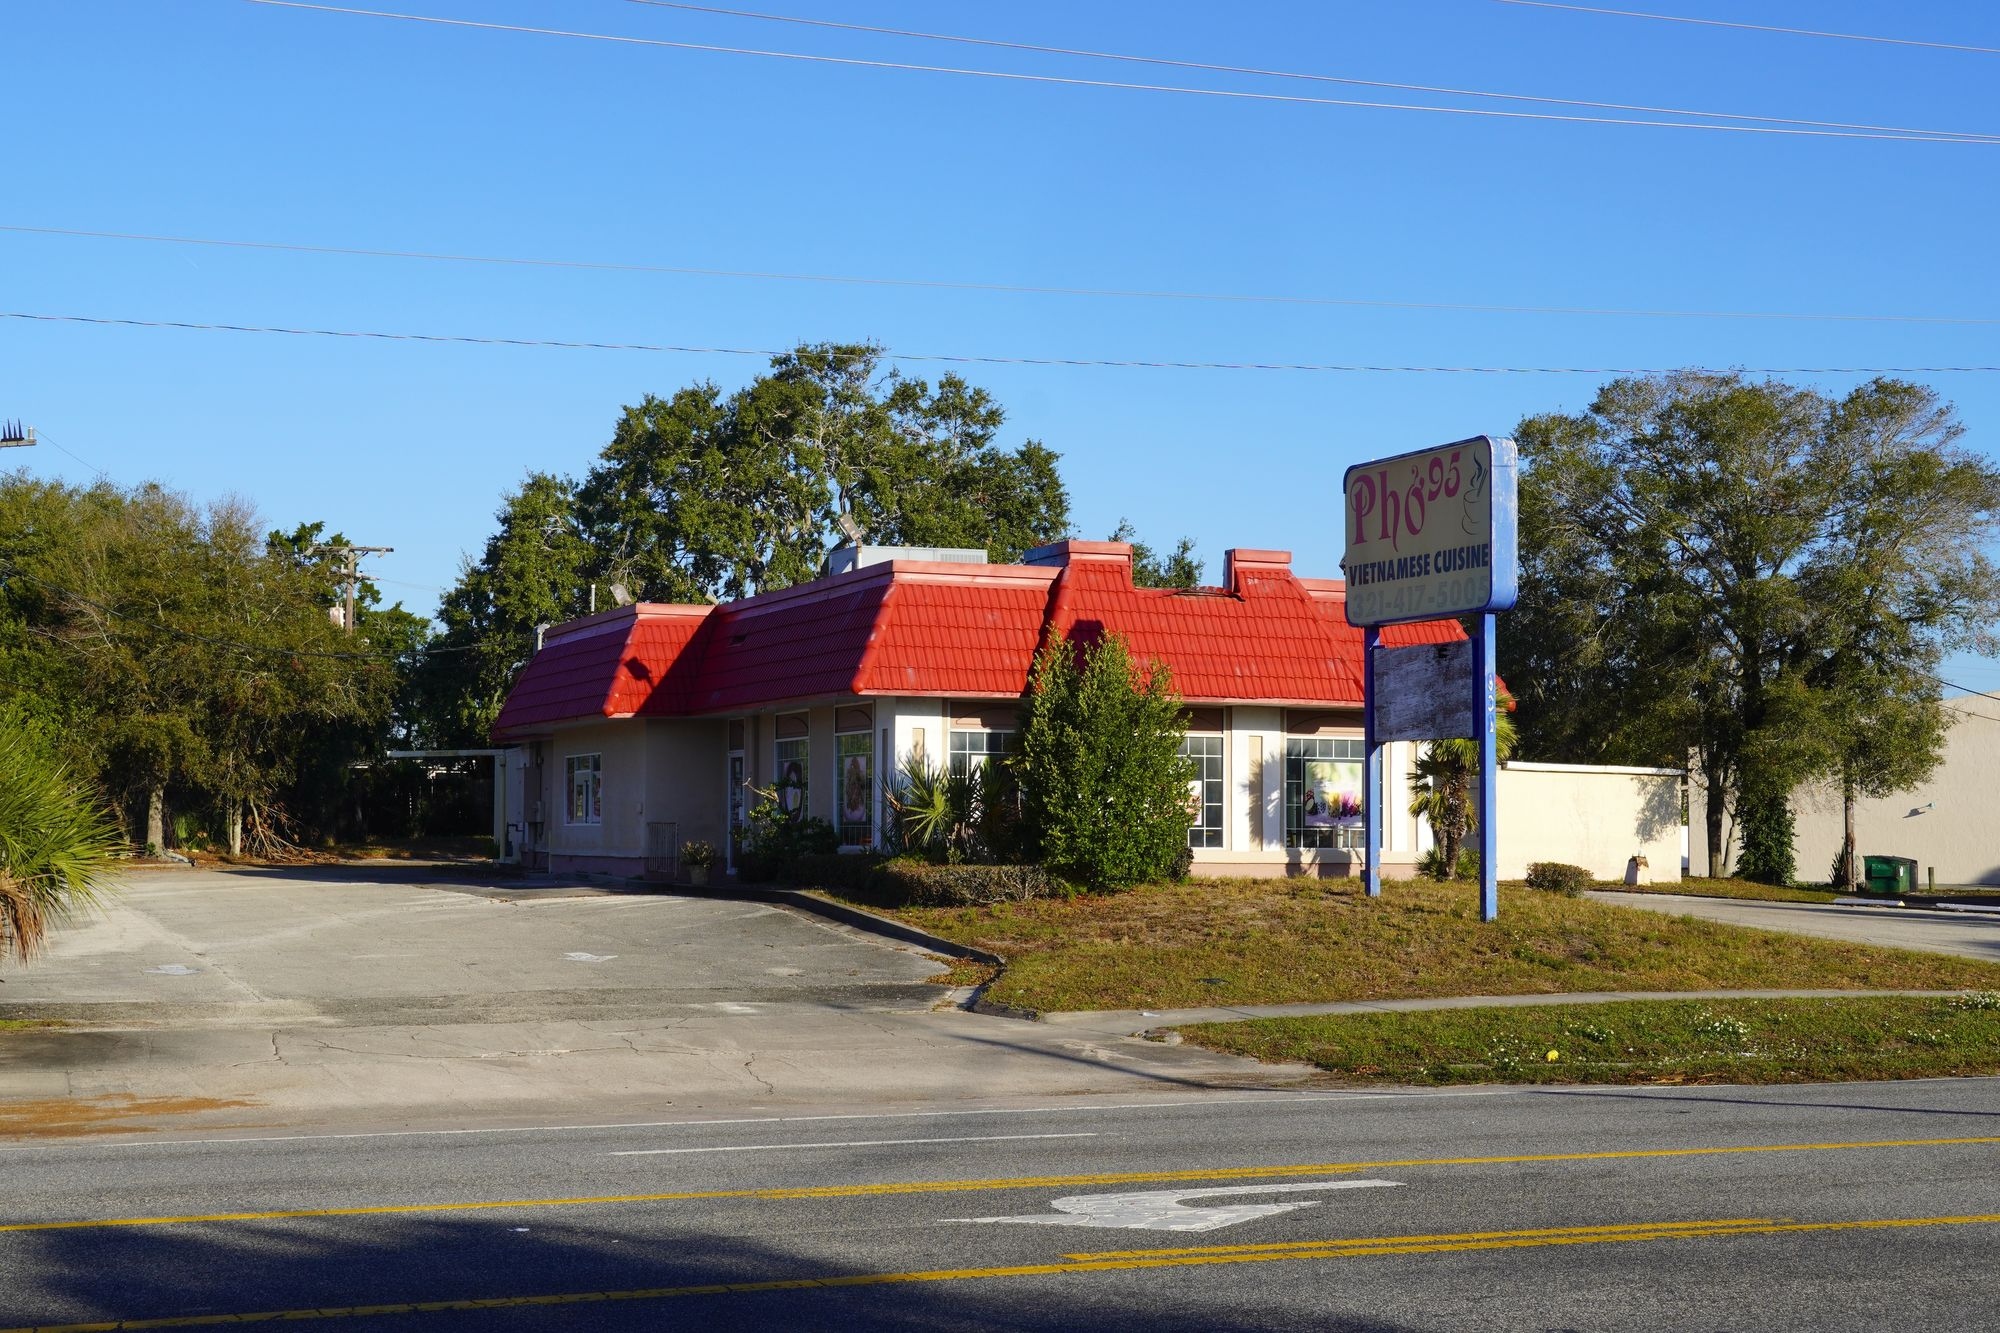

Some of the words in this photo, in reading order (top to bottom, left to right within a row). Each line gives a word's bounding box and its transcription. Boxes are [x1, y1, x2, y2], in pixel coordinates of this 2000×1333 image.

[1428, 451, 1461, 502] 95
[1349, 553, 1430, 586] VIETNAMESE
[1433, 543, 1489, 573] CUISINE
